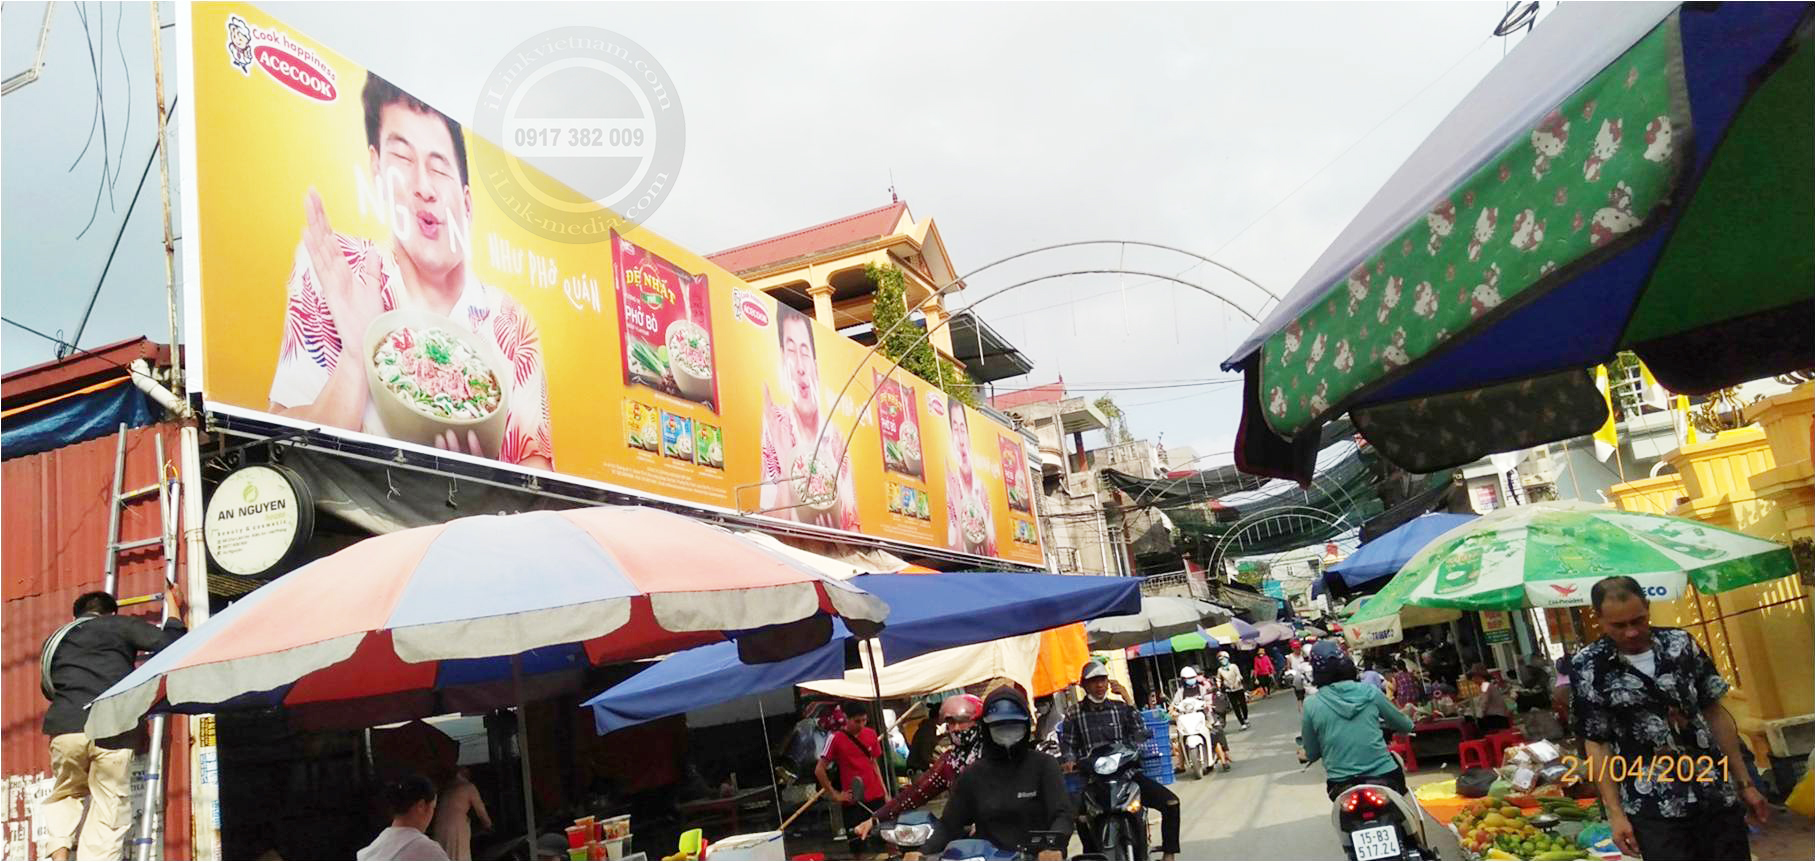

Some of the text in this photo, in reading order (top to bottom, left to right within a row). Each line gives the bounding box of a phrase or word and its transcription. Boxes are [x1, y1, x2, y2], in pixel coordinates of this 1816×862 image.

[252, 28, 336, 81] Cook happiness
[217, 498, 286, 521] AN NGUYEN
[1360, 829, 1390, 845] 15-B3
[1358, 842, 1397, 859] 517.24
